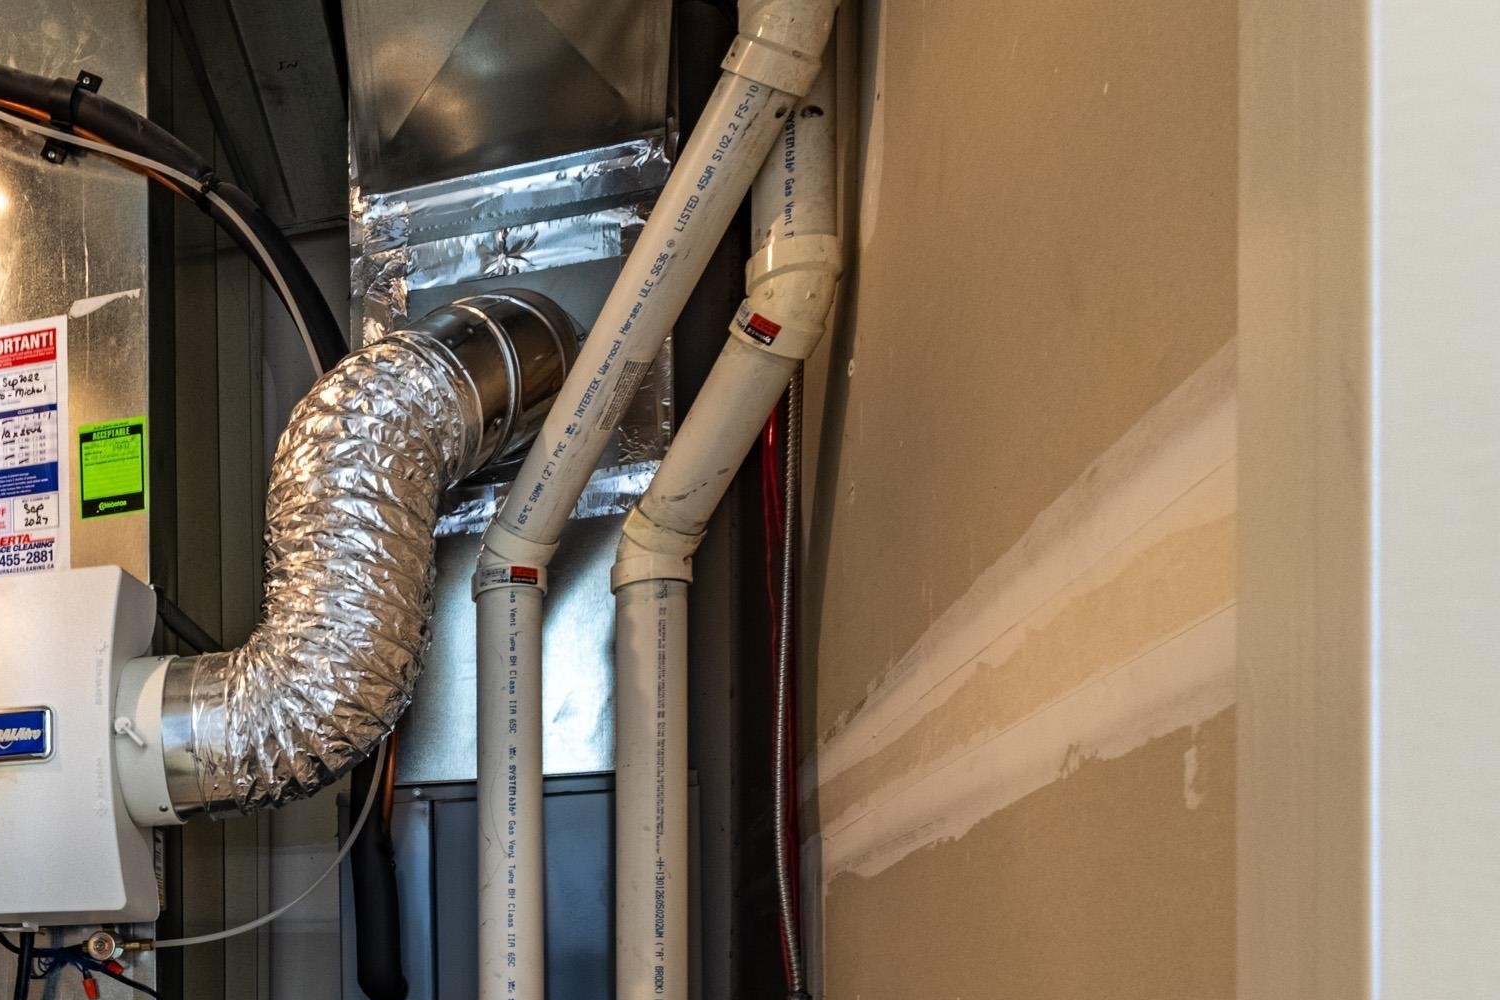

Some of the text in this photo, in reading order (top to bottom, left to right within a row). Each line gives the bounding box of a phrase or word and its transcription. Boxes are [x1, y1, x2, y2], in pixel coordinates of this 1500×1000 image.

[784, 178, 795, 197] Gas
[784, 201, 794, 226] Vent
[552, 441, 567, 459] PVC
[573, 376, 602, 418] INTERTEK
[596, 338, 622, 376] Warnock
[618, 300, 643, 336] Hersey
[673, 193, 700, 233] LISTED
[92, 426, 131, 440] ACCEPTABLE
[24, 503, 44, 518] Sep
[13, 542, 53, 552] CLEANING
[510, 608, 518, 626] Vent
[509, 670, 517, 695] Class
[508, 820, 516, 835] Gas
[507, 840, 516, 859] Vent
[507, 903, 516, 928] Class
